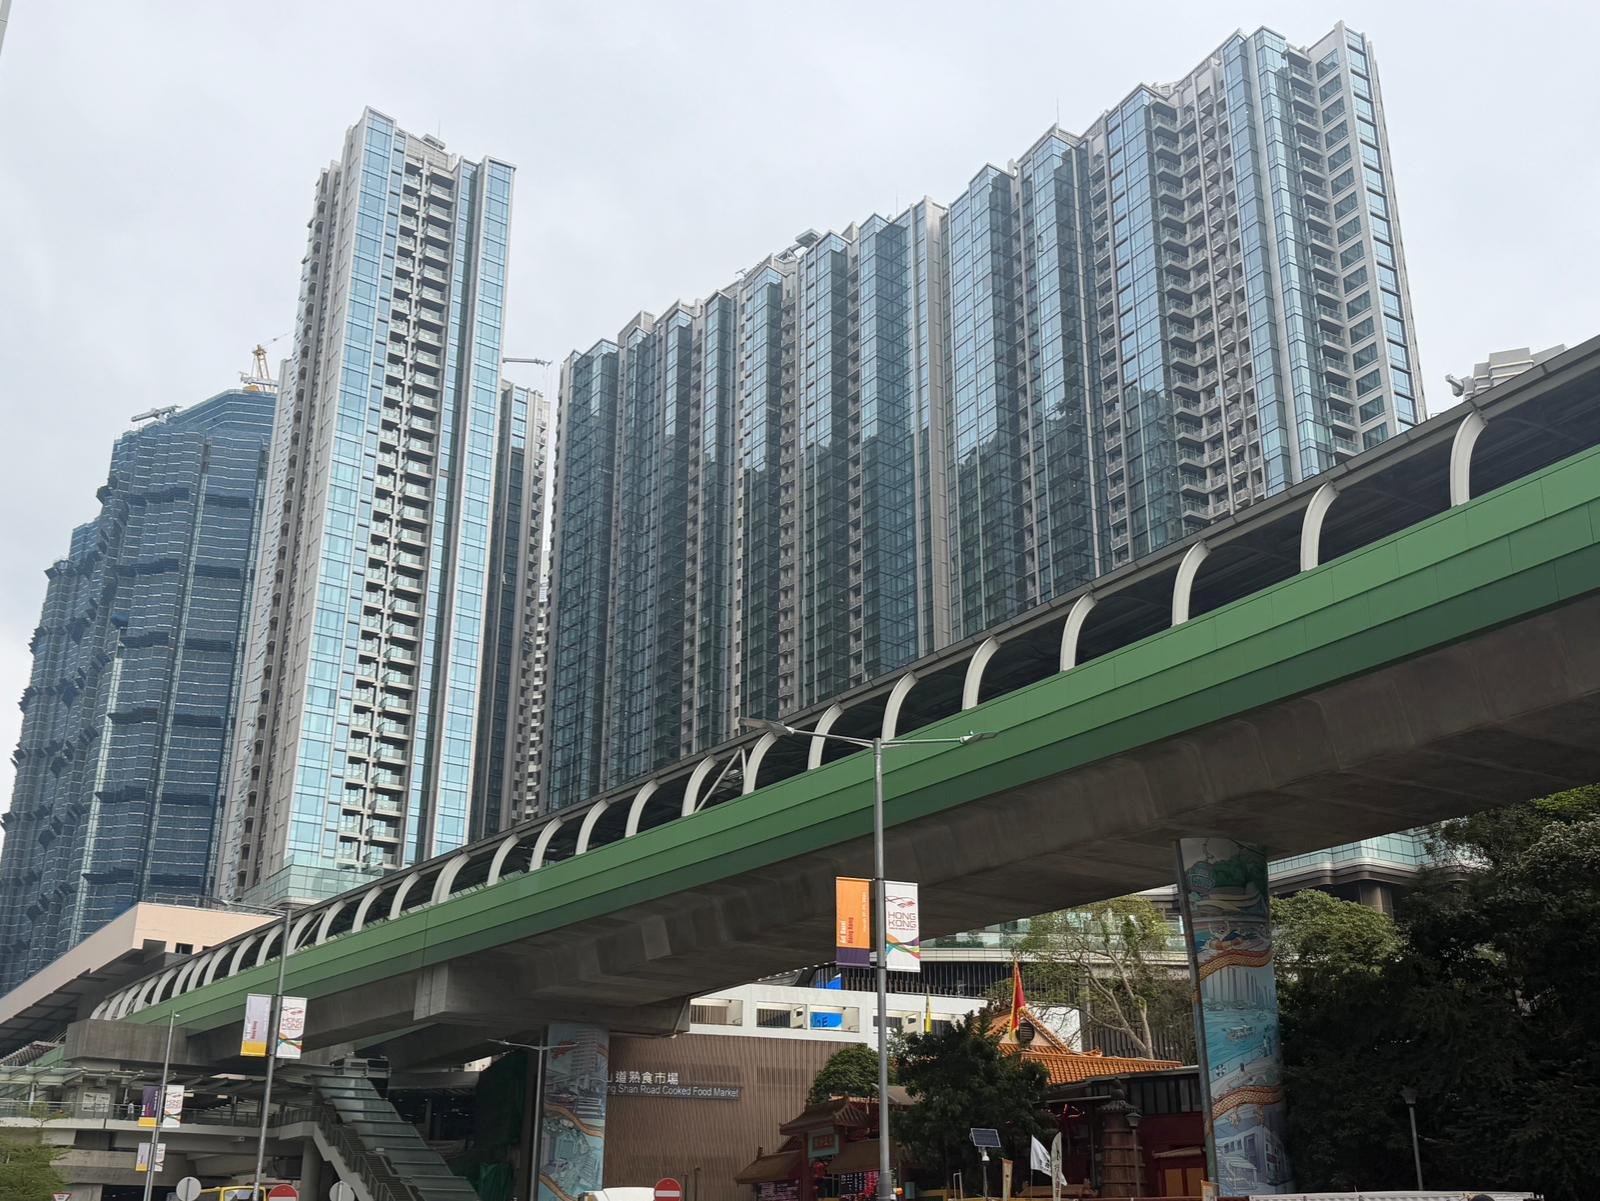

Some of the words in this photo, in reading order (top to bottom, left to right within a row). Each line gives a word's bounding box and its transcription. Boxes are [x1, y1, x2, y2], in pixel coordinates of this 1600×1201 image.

[888, 911, 916, 920] HONG
[888, 920, 917, 928] KONG
[619, 1084, 638, 1093] Shan
[640, 1085, 660, 1095] Road
[662, 1085, 692, 1096] Cooked
[692, 1086, 712, 1096] Food
[713, 1087, 740, 1097] Market
